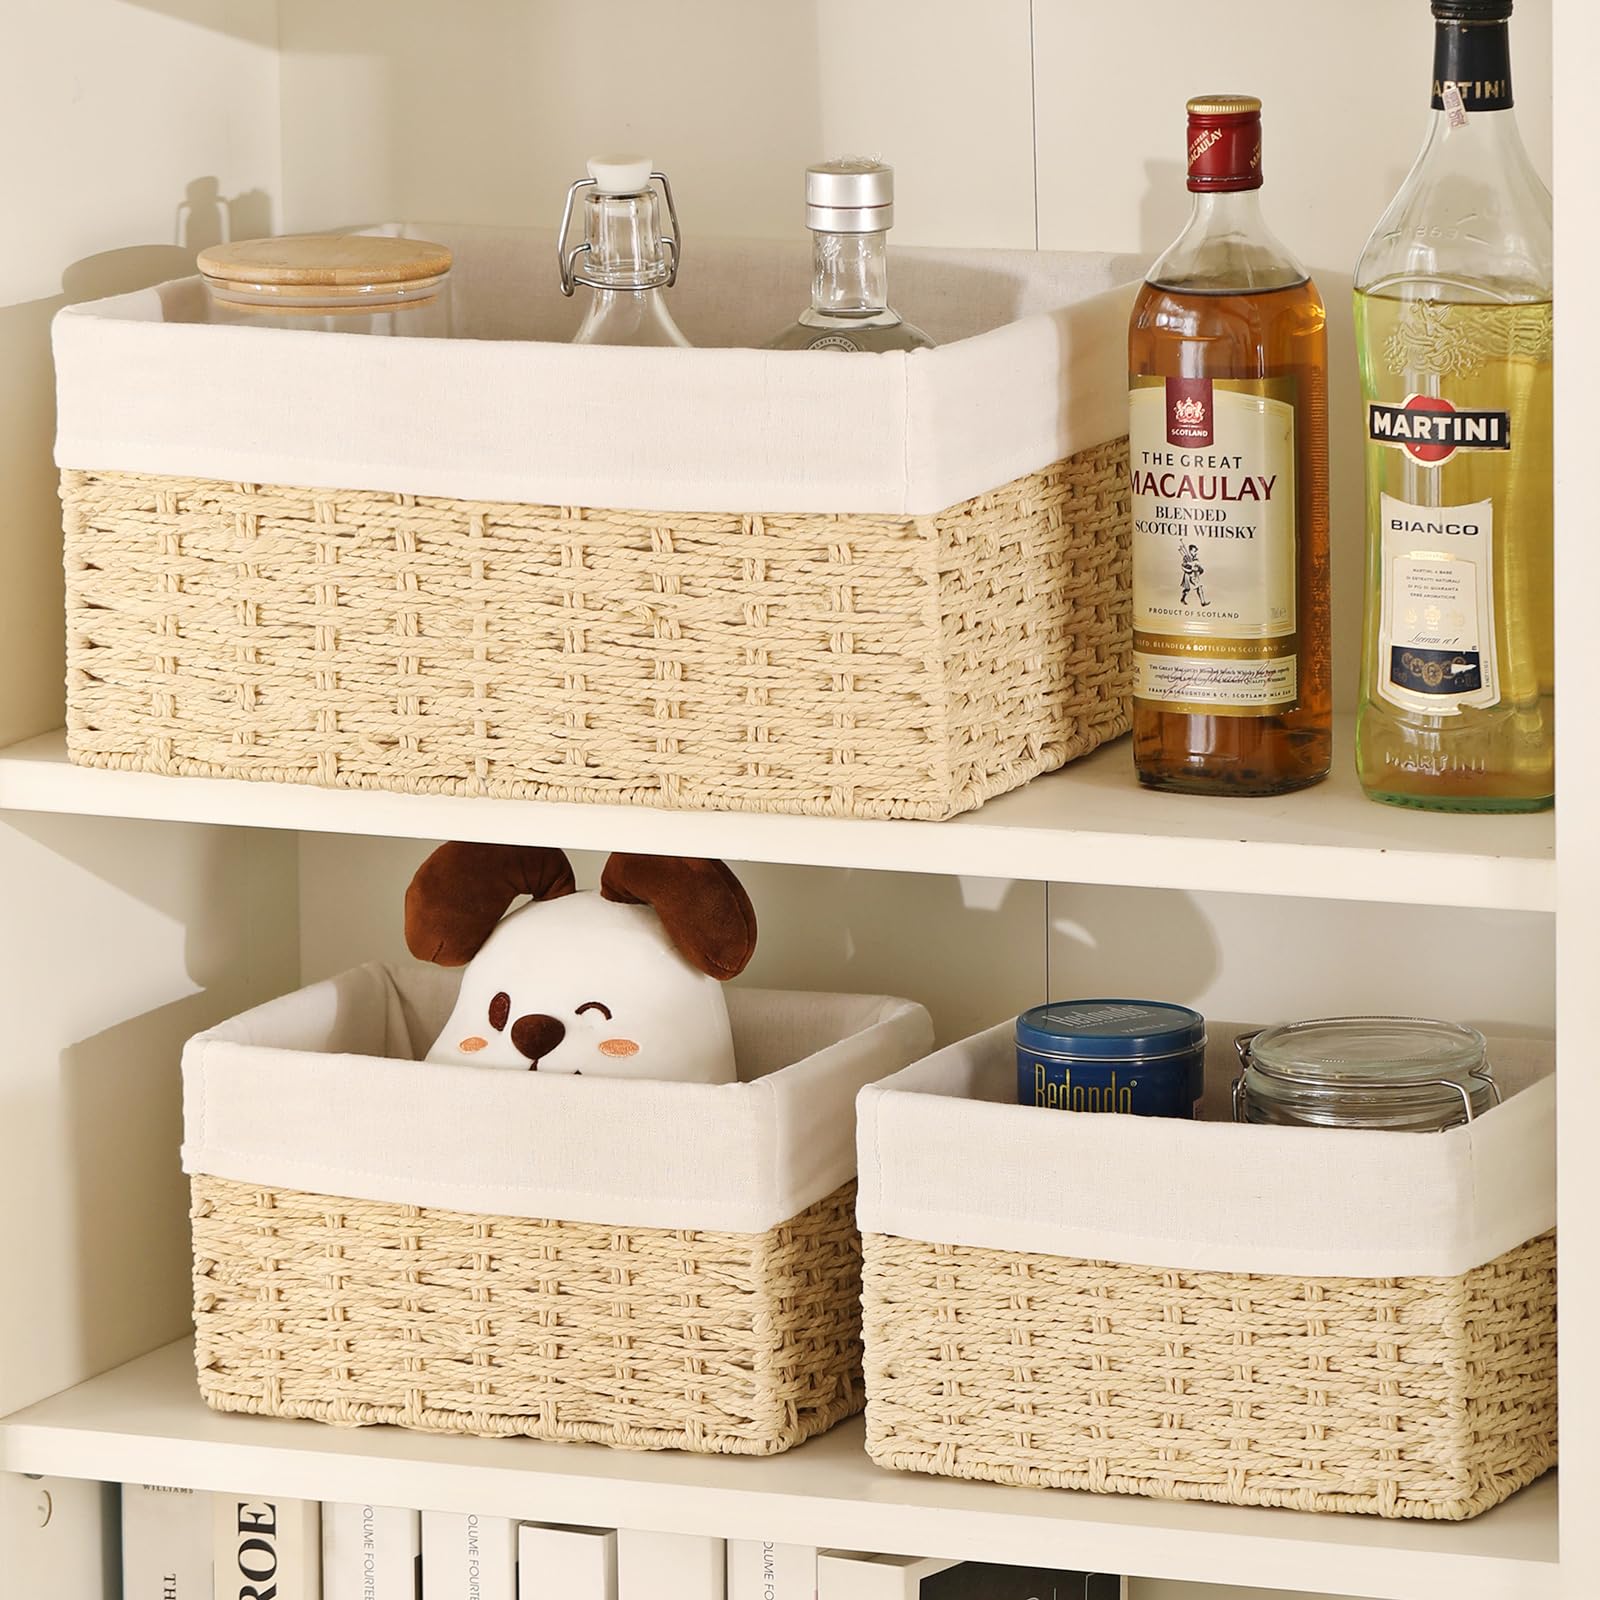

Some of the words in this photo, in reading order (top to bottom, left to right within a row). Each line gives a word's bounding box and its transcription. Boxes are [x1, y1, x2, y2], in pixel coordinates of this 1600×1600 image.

[1171, 428, 1209, 438] SCOTLAND
[1373, 410, 1500, 441] MARTINI
[1142, 451, 1174, 466] THE
[1181, 454, 1243, 470] GREAT
[1130, 470, 1277, 501] MACAULAY
[1155, 506, 1227, 522] BLENDED
[1135, 519, 1188, 537] SCOTCH
[1194, 525, 1257, 540] WHISKY
[1391, 519, 1479, 536] BIANCO
[1148, 607, 1183, 617] PRODUCT
[1184, 609, 1195, 618] OF
[1196, 609, 1240, 620] SCOTLAND
